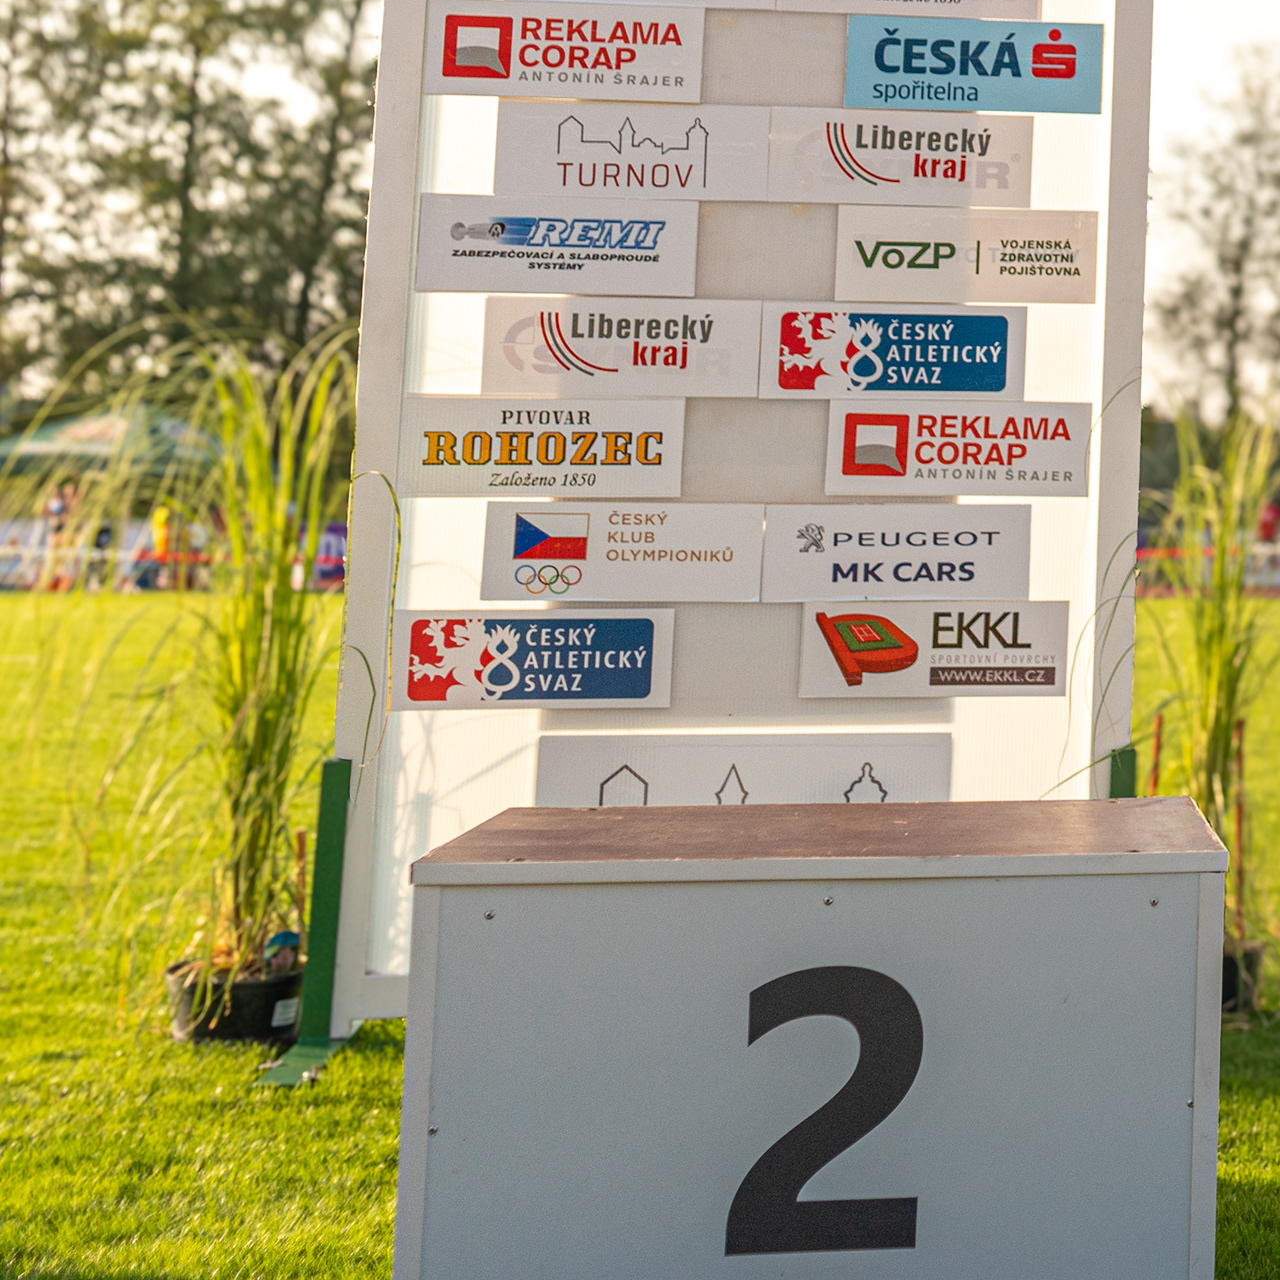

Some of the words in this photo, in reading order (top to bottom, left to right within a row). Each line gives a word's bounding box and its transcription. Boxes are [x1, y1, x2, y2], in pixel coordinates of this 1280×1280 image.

[520, 17, 683, 46] REKLAMA
[518, 43, 637, 70] CORAP
[874, 27, 1022, 78] ČESKÁ
[518, 68, 607, 84] ANTONÍN
[613, 71, 685, 87] ŠRAJER
[872, 80, 979, 104] spořitelna
[855, 123, 992, 157] Liberecký
[556, 162, 693, 189] TURNOV
[913, 153, 968, 183] kraj
[527, 218, 667, 249] REMI
[999, 238, 1073, 250] VOJENSKÁ
[452, 248, 554, 261] ZABEZPEČOVACÍ
[556, 252, 565, 260] A
[568, 249, 660, 262] SLABOPROUDÉ
[528, 259, 585, 271] SYSTÉMY
[999, 251, 1074, 263] ZDRAVOTNÍ
[999, 264, 1081, 277] POJIŠŤOVNA
[571, 313, 714, 344] Liberecký
[888, 319, 954, 341] ČESKÝ
[633, 341, 689, 370] kraj
[886, 341, 1002, 364] ATLETICKÝ
[887, 364, 942, 385] SVAZ
[500, 409, 592, 426] PIVOVAR
[916, 414, 1071, 442] REKLAMA
[422, 431, 664, 467] ROHOZEC
[913, 441, 1028, 466] CORAP
[488, 470, 557, 489] Založeno
[559, 473, 597, 487] 1850
[914, 465, 1001, 480] ANTONÍN
[1004, 467, 1074, 482] ŠRAJER
[609, 509, 668, 526] ČESKÝ
[607, 531, 656, 544] KLUB
[833, 530, 1001, 547] PEUGEOT
[605, 545, 733, 564] OLYMPIONIKŮ
[831, 562, 883, 583] MK
[892, 561, 975, 583] CARS
[525, 623, 597, 647] ČESKÝ
[933, 611, 1032, 649] EKKL
[524, 645, 648, 669] ATLETICKÝ
[930, 651, 998, 665] SPORTOVNÍ
[1002, 654, 1057, 665] POVRCHY
[524, 670, 582, 691] SVAZ
[938, 669, 1046, 683] WWW.EKKL.CZ
[725, 966, 923, 1256] 2
